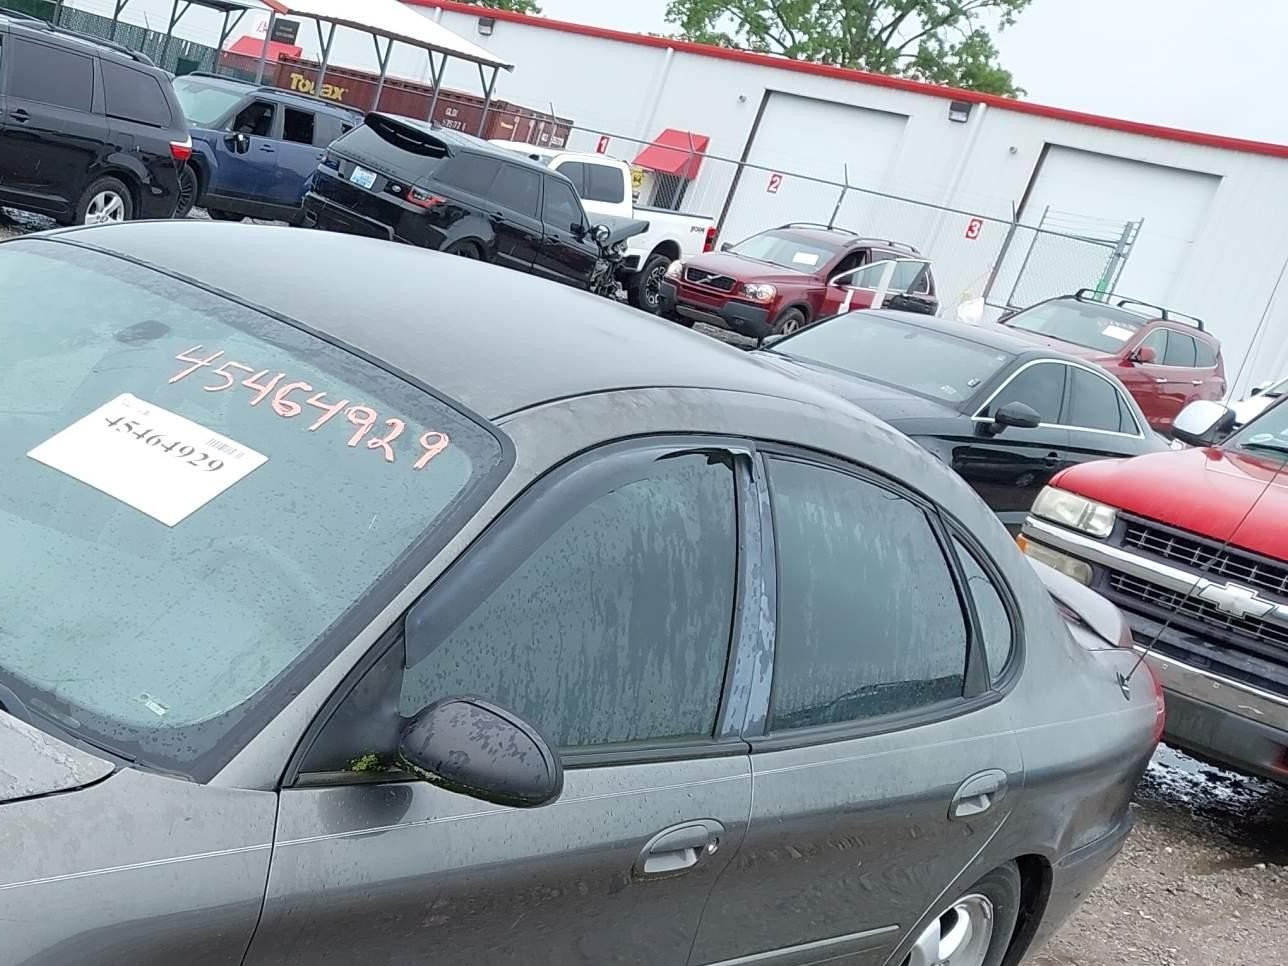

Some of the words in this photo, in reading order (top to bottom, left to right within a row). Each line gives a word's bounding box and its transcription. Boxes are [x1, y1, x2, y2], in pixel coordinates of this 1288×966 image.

[768, 175, 781, 192] 2
[966, 220, 982, 238] 3
[167, 344, 450, 471] 45464929
[104, 416, 225, 472] 45464929
